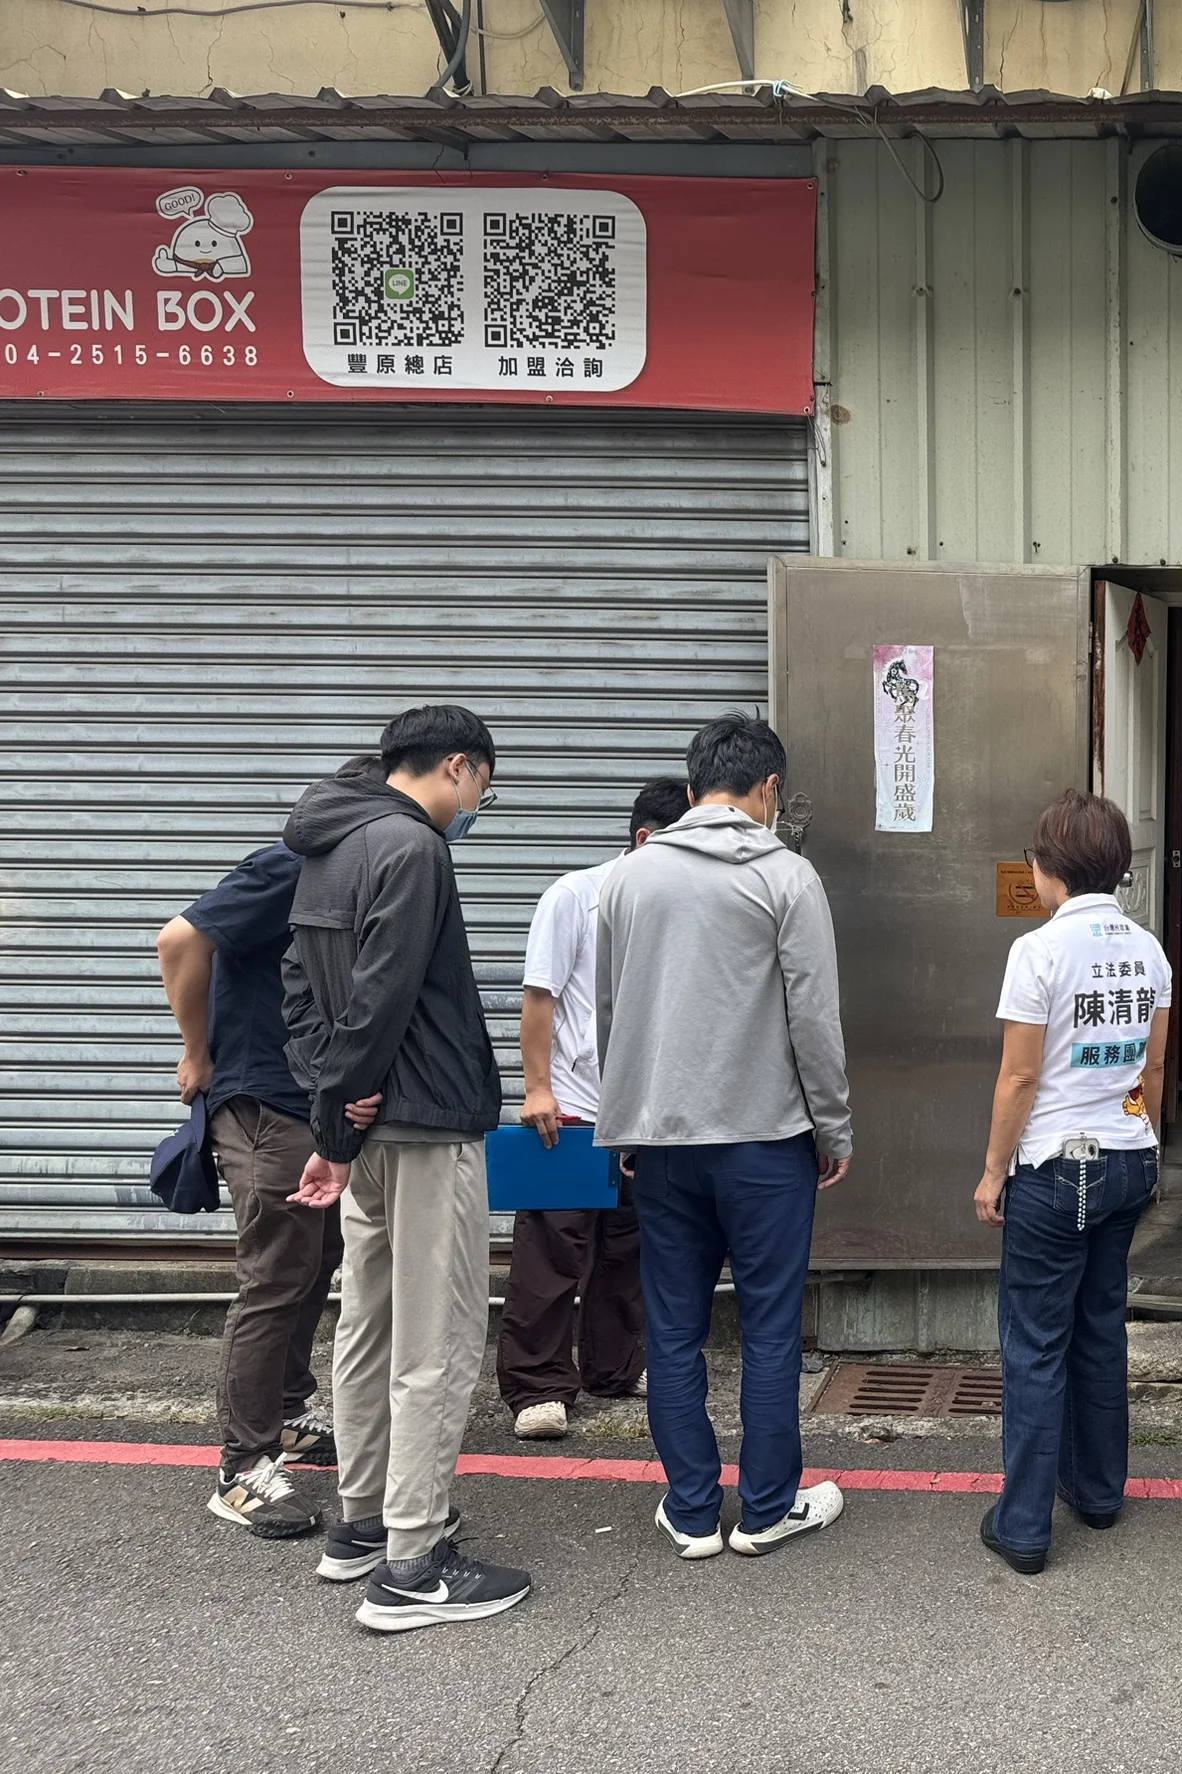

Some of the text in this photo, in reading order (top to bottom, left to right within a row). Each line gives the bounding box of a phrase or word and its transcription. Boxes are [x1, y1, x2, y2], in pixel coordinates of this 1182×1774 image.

[164, 193, 196, 211] GOOD!
[0, 288, 256, 332] OTEIN BOX
[5, 343, 258, 366] 04-2515-6638
[347, 353, 453, 376] 豐原總店
[498, 355, 604, 378] 加盟洽詢
[1091, 961, 1146, 978] 立法委員
